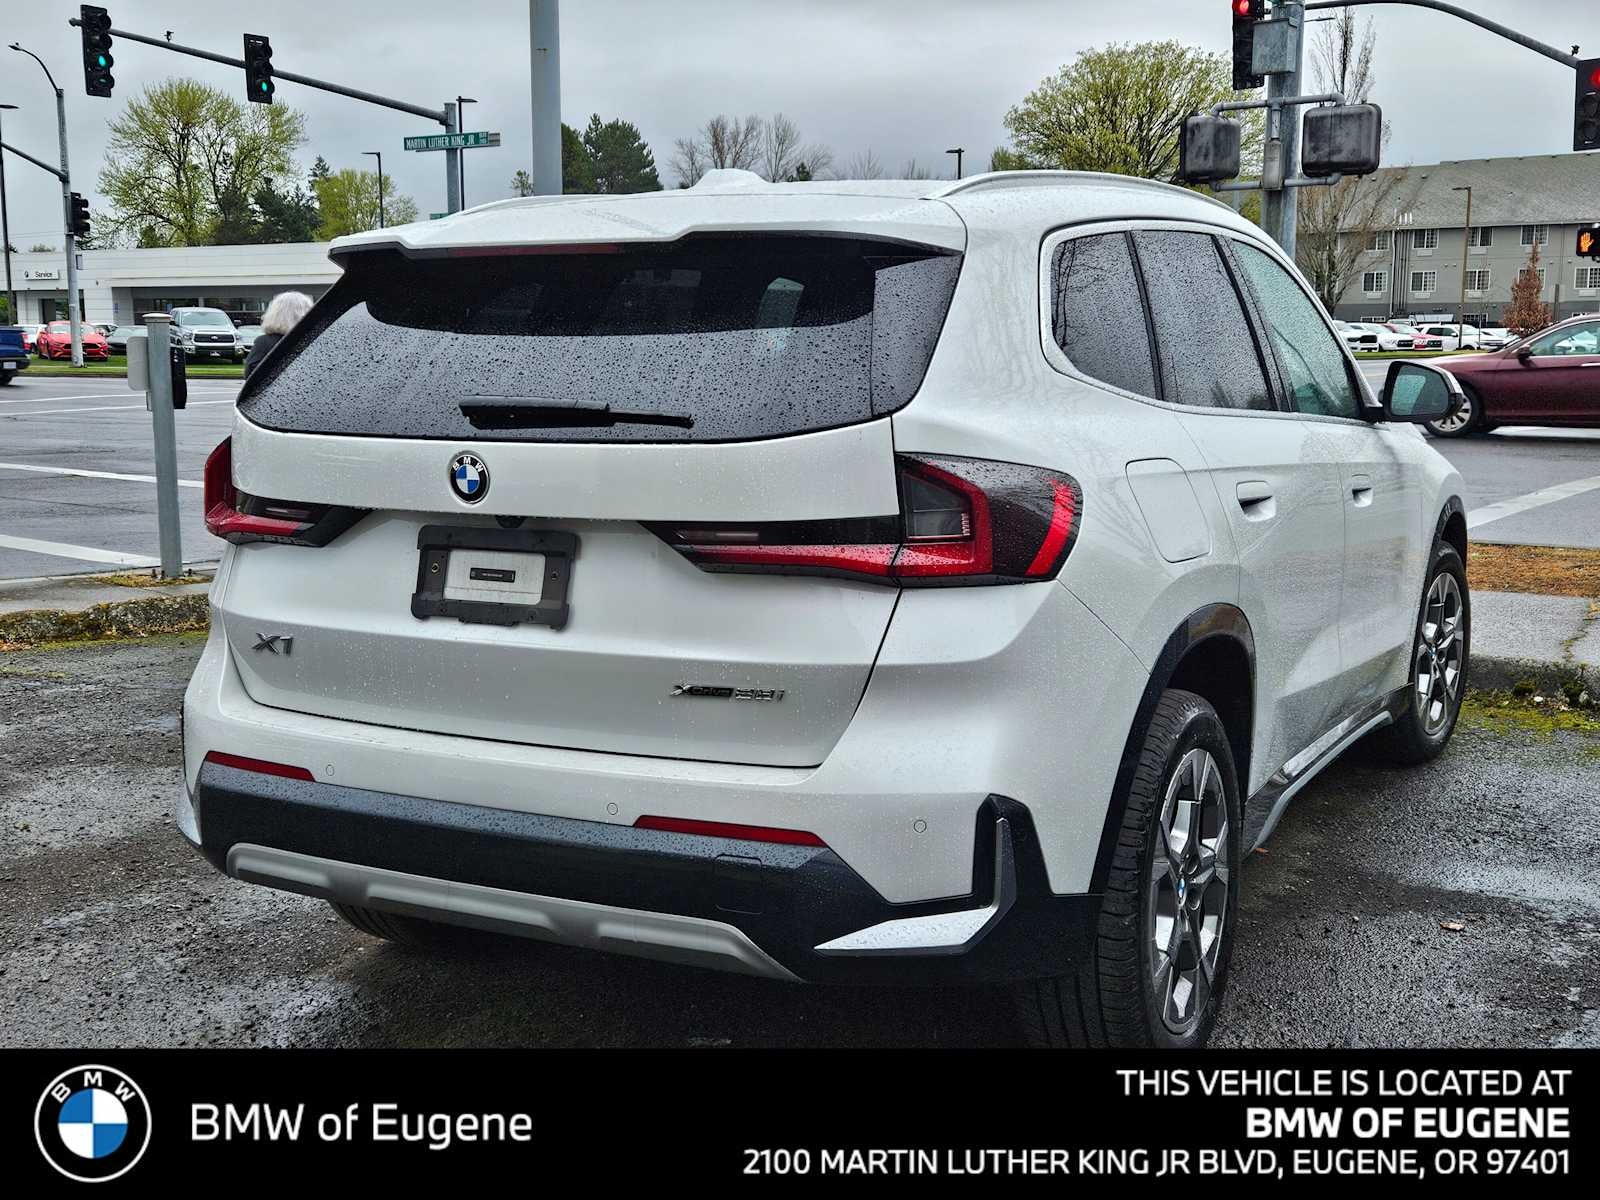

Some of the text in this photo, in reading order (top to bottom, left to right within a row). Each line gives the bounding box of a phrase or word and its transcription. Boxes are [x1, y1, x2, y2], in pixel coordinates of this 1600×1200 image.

[405, 137, 427, 149] MARTIN
[428, 136, 449, 148] LUTHER
[451, 135, 465, 147] KING
[467, 134, 475, 145] JR
[452, 456, 483, 472] BMW
[252, 632, 293, 655] X1
